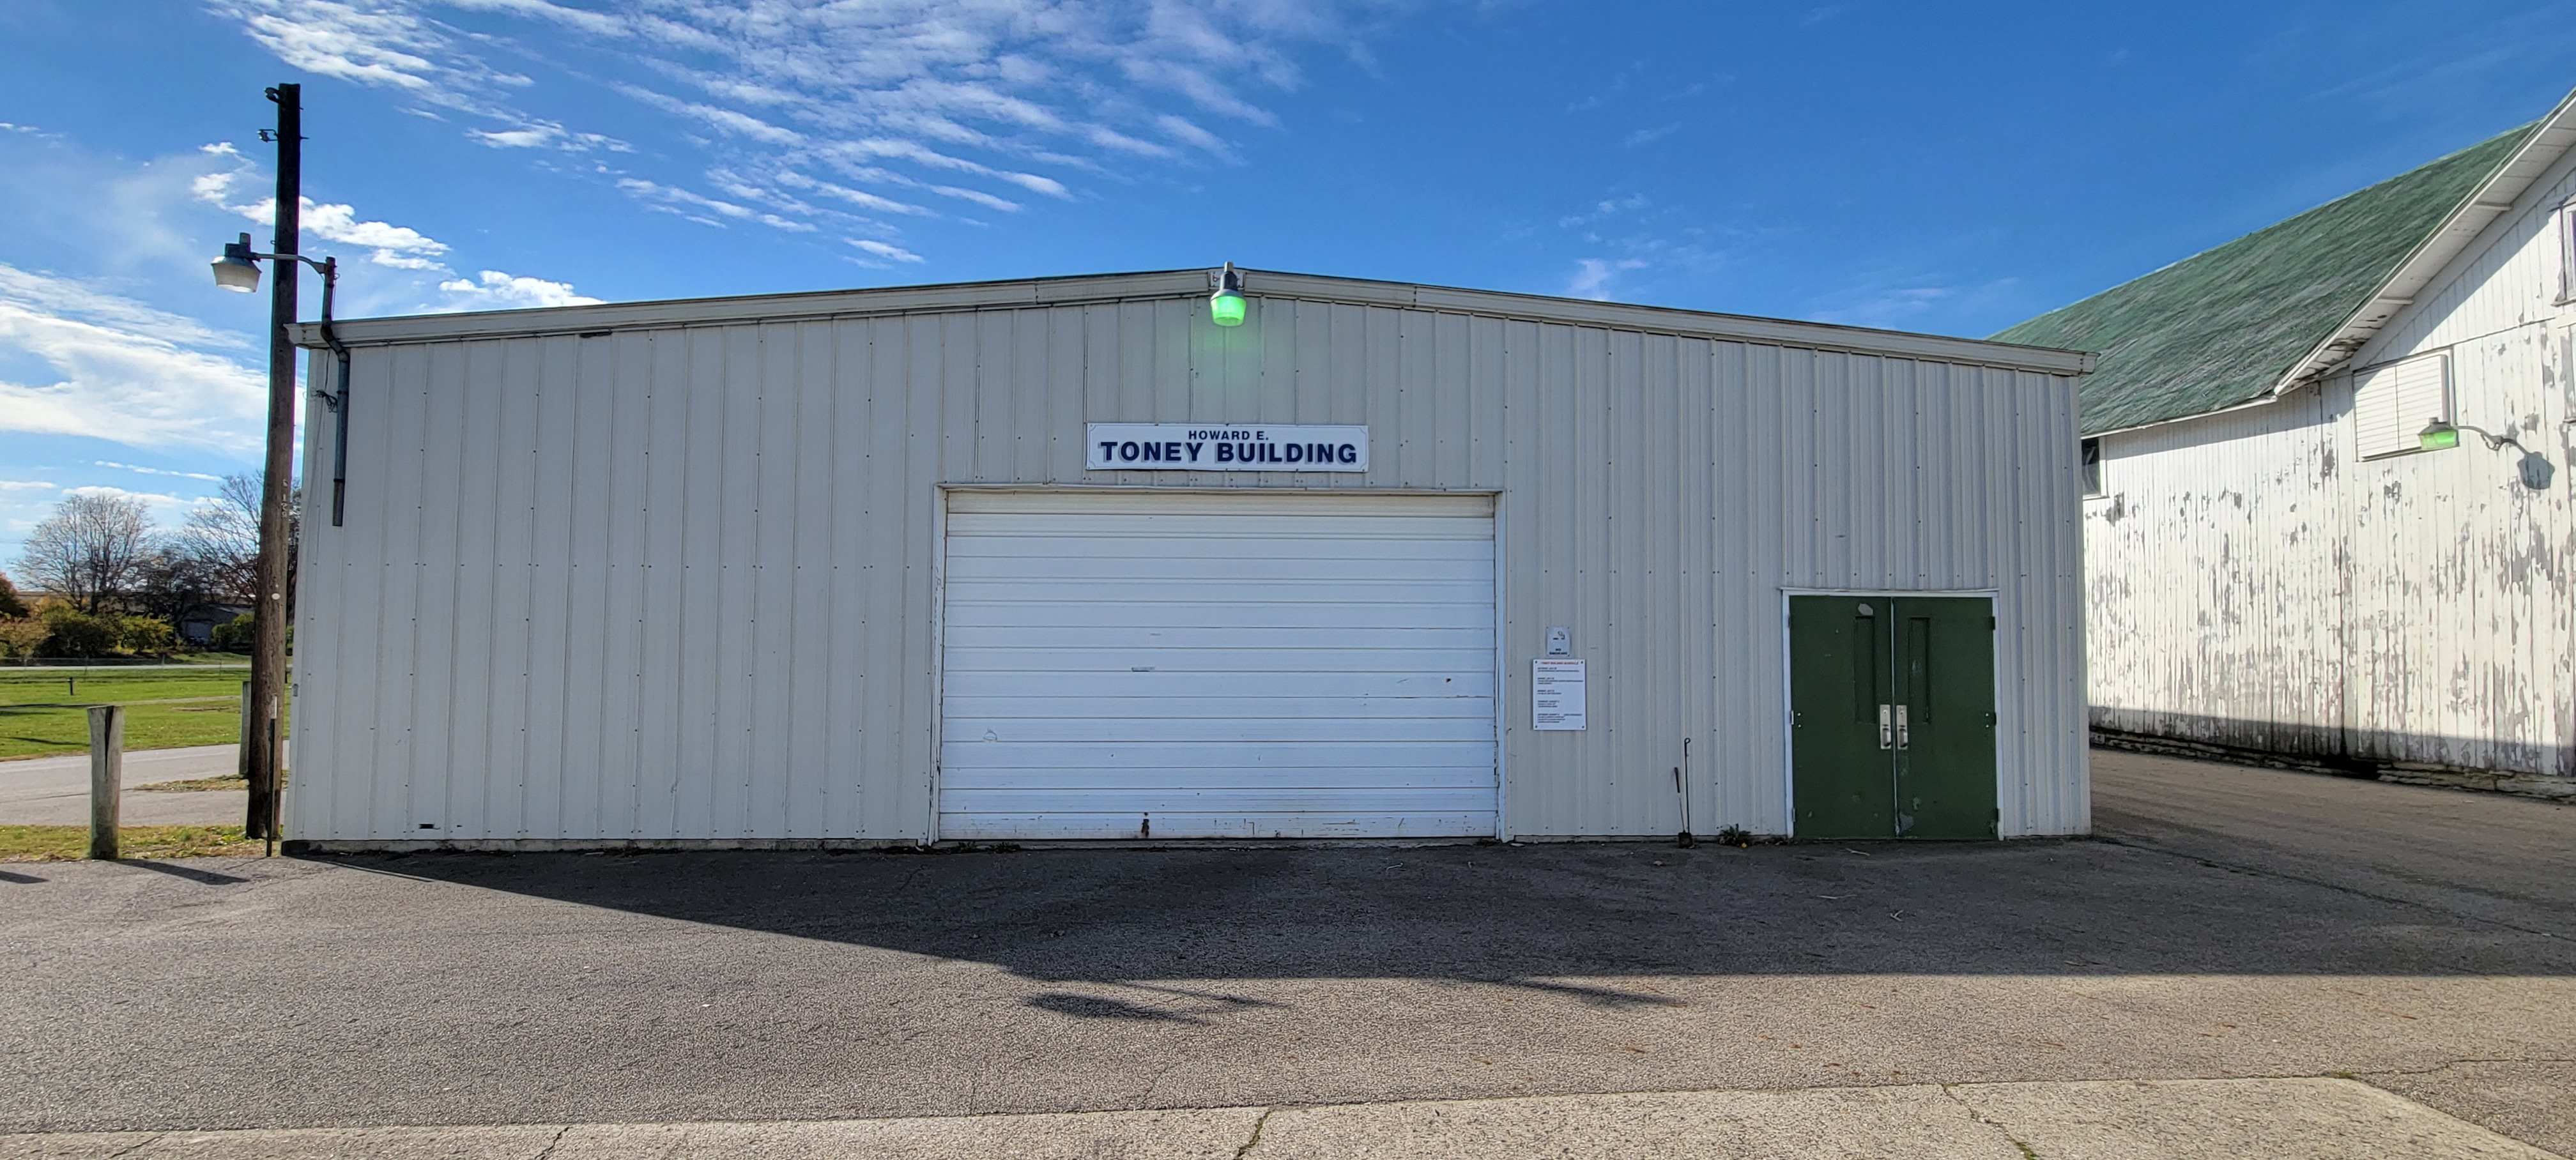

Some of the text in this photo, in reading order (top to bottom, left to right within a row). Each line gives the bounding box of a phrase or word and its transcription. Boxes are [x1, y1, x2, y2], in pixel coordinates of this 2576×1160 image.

[1188, 430, 1269, 441] HOWARD E.
[1100, 441, 1357, 463] TONEY BUILDING
